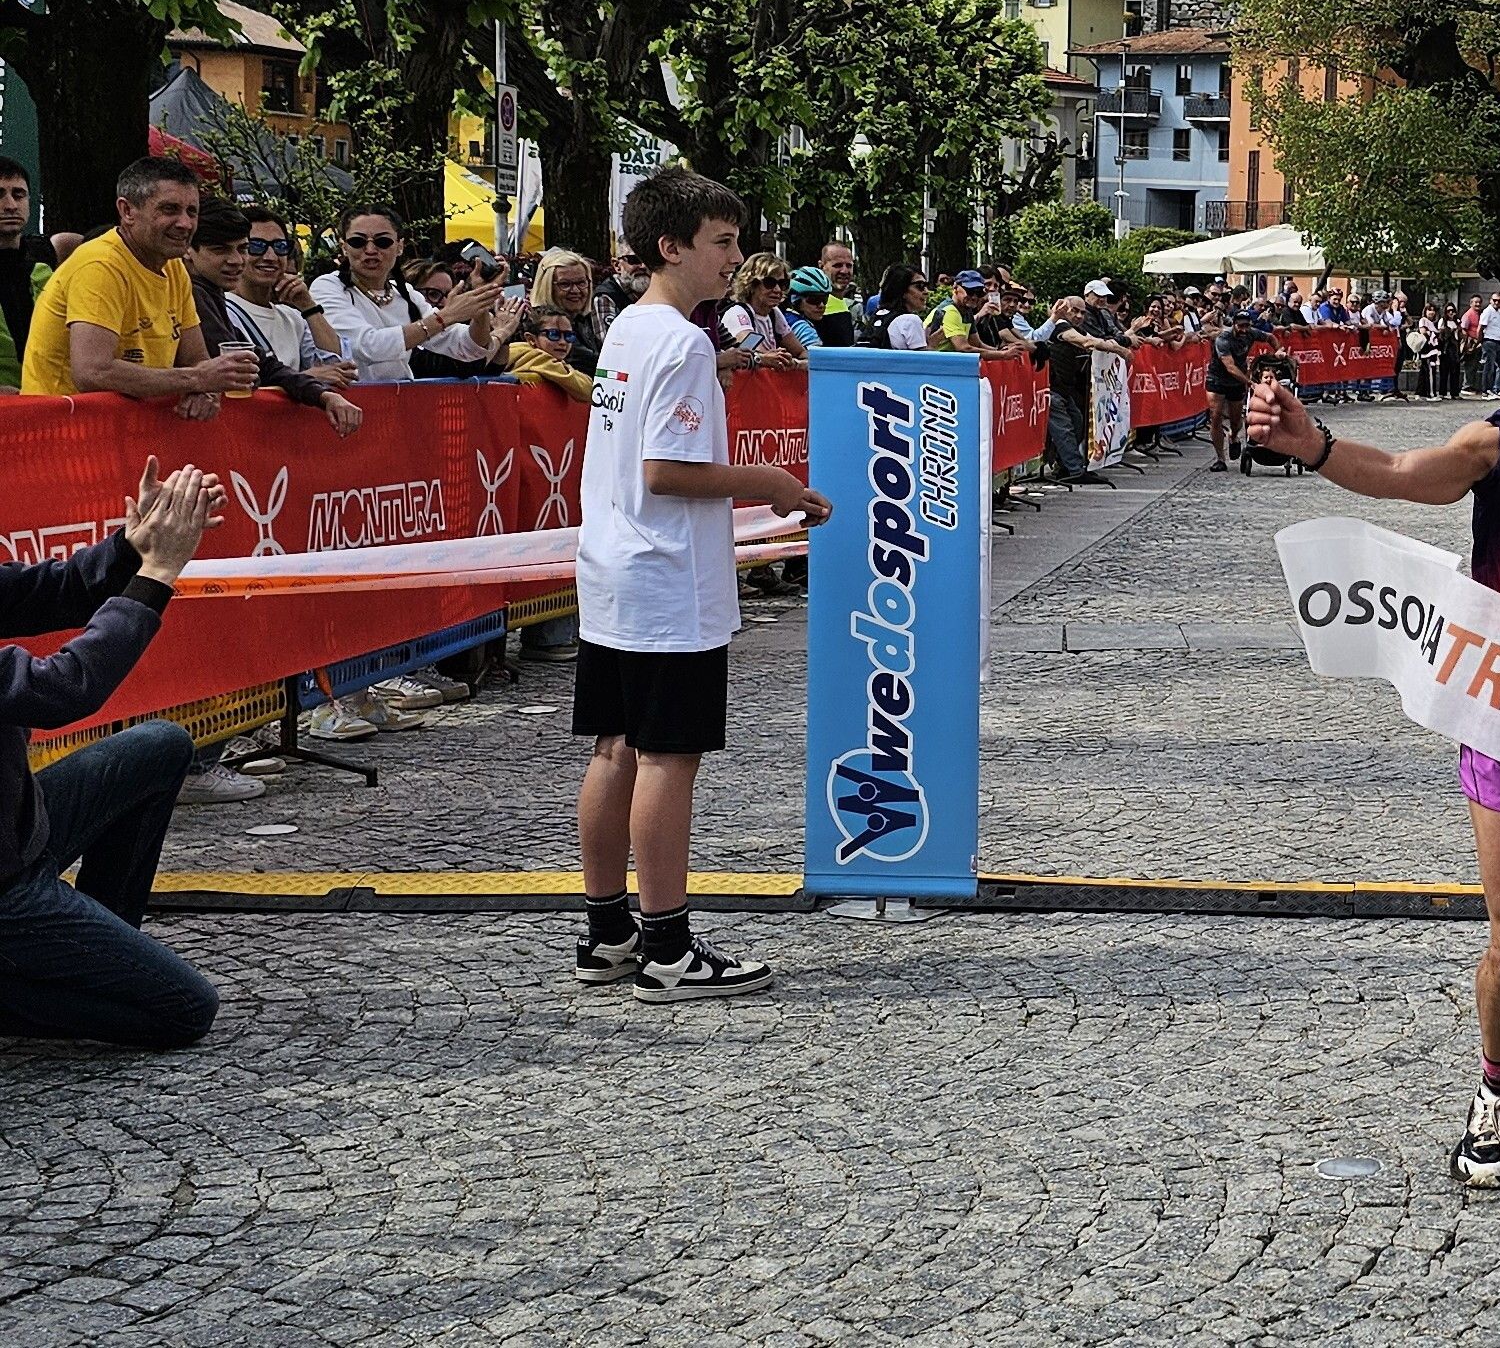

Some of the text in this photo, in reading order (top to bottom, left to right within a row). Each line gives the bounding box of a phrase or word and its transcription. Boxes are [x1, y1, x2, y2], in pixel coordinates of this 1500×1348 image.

[734, 429, 809, 467] MONTU
[919, 383, 959, 531] CHRONO
[307, 479, 446, 553] MONTURA
[851, 382, 930, 773] wedosport
